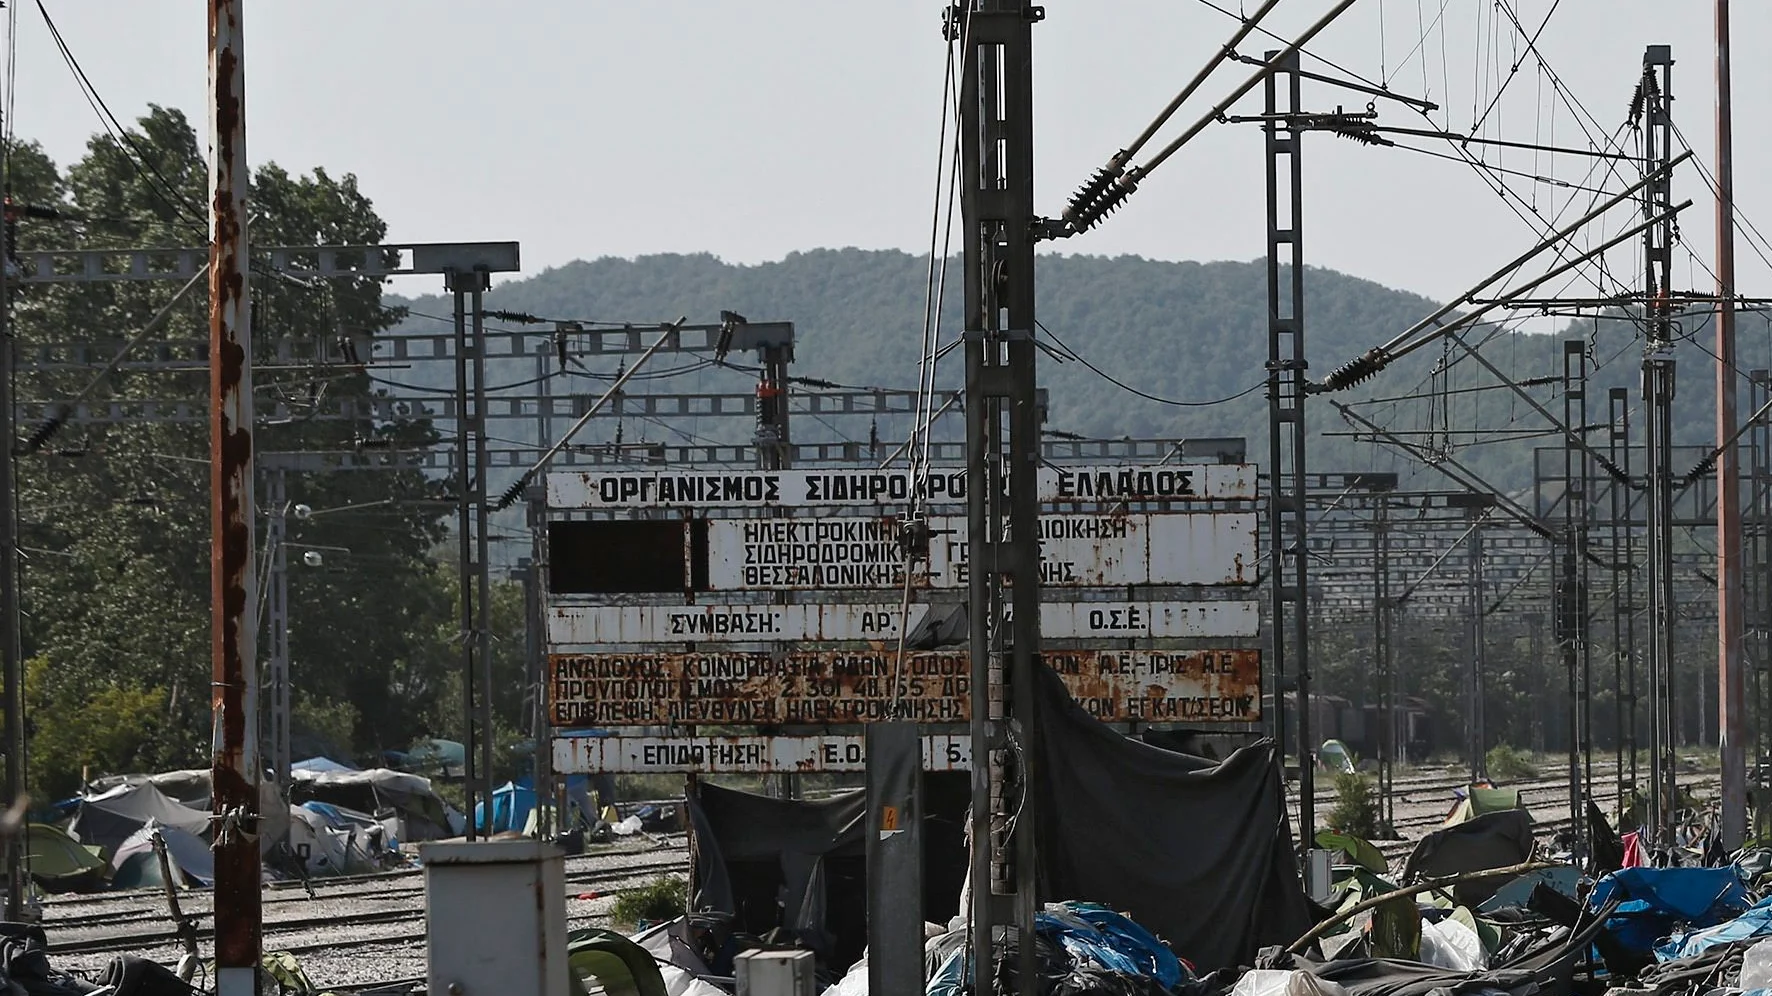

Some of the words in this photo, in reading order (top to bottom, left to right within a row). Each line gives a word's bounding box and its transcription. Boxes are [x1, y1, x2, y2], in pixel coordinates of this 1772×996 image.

[600, 475, 780, 502] ΟΡΓΑΝΙΣΜΟΣ
[1058, 471, 1195, 497] ΕΛΛΑΔΟΣ
[744, 565, 903, 585] ΘΕΣΣΑΛΟΝΙΚΗΣ
[671, 612, 781, 634] ΣΥΜΒΑΣΗ:
[861, 612, 897, 633] ΑΡ.
[1089, 609, 1146, 630] Ο.Σ.Ε.
